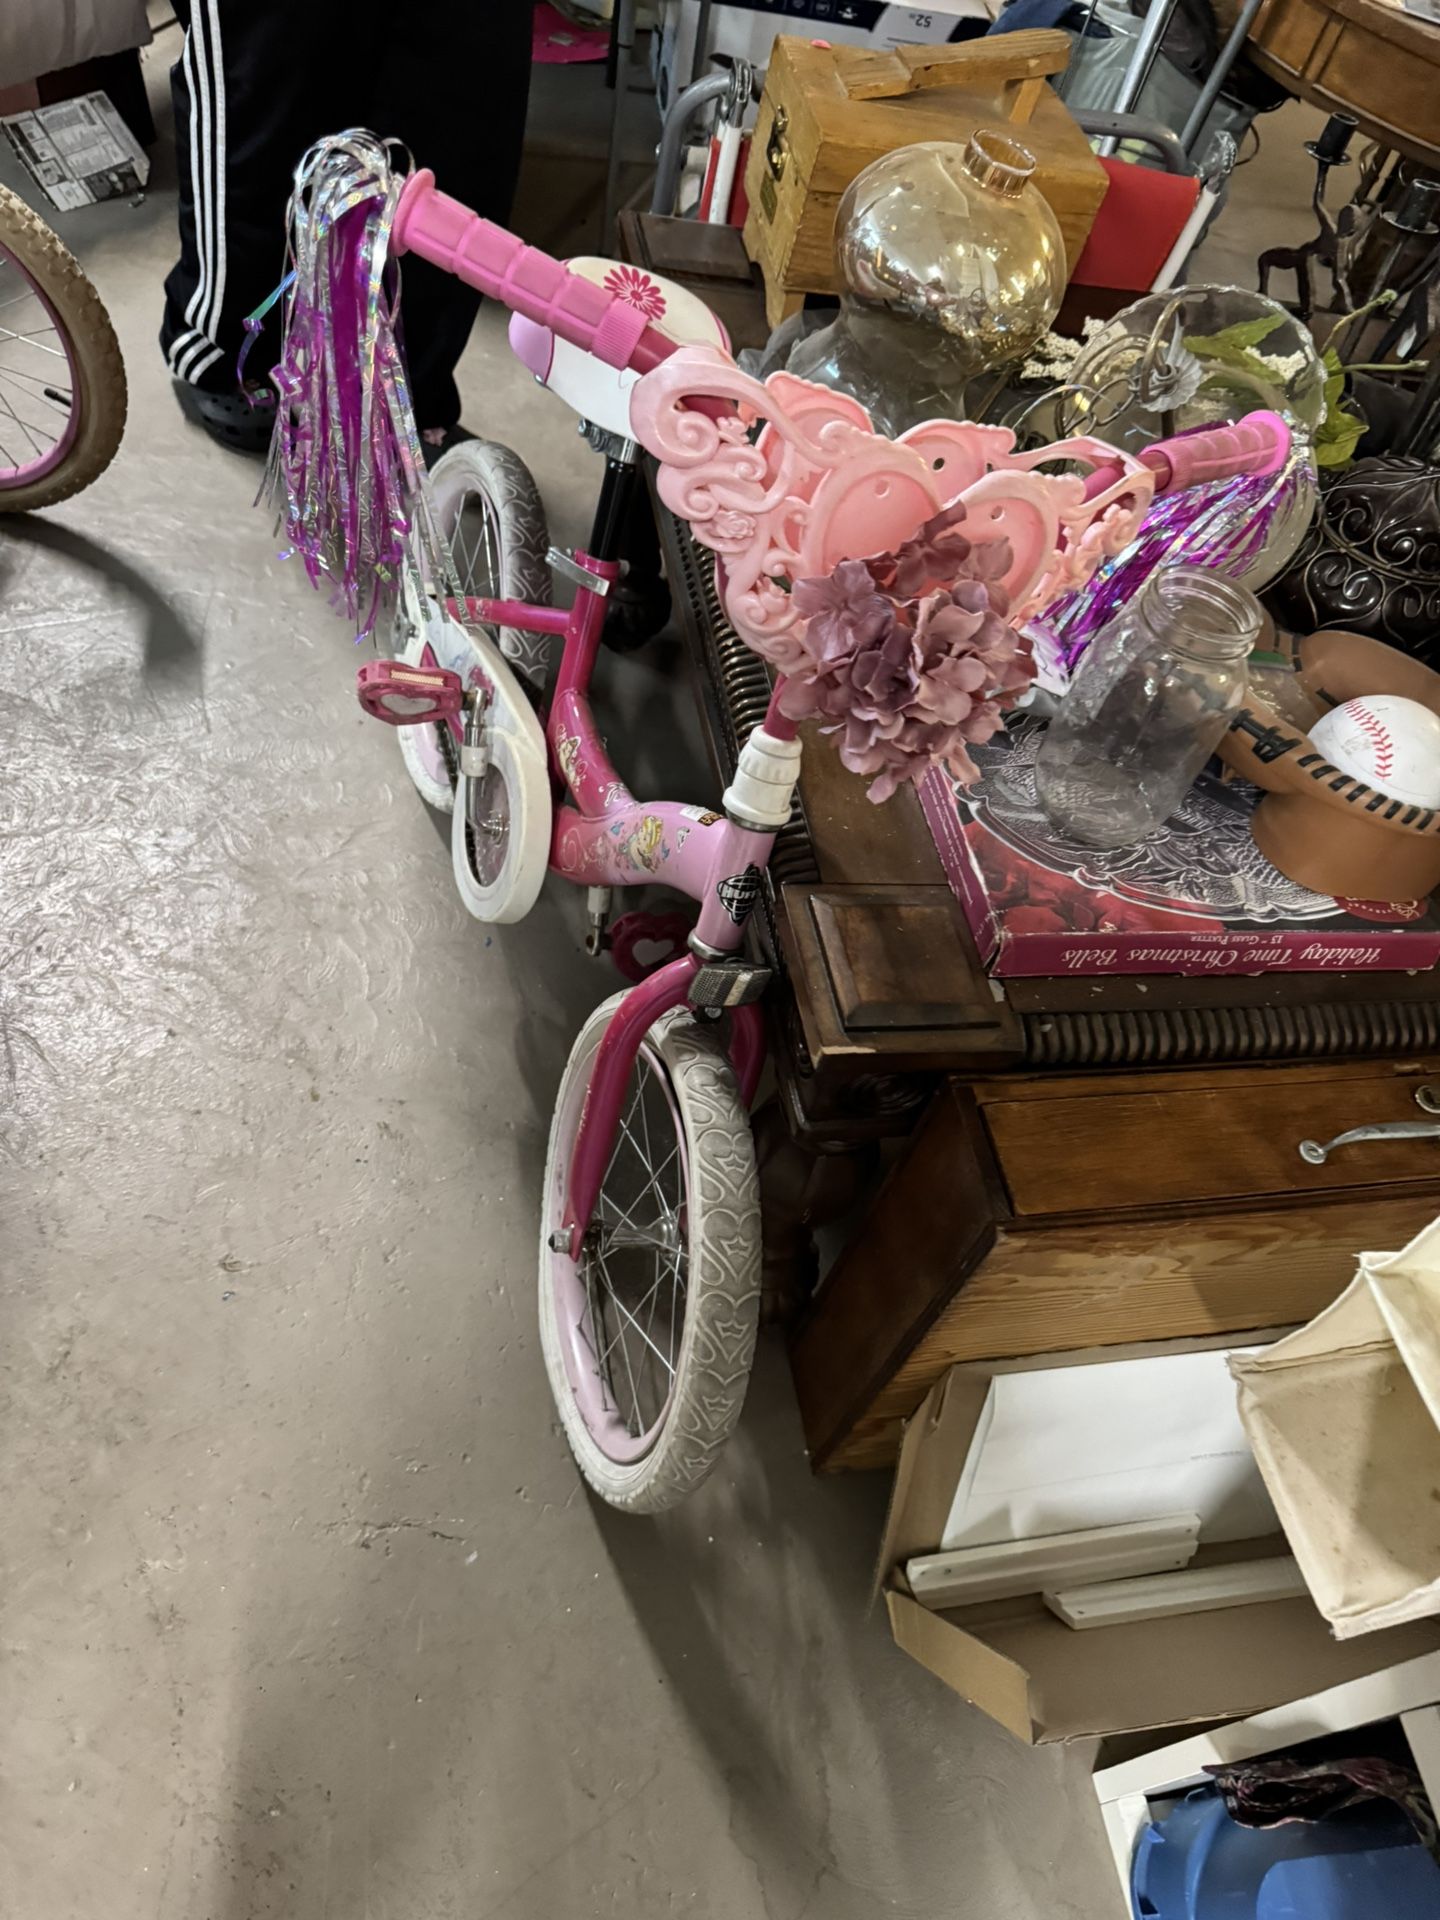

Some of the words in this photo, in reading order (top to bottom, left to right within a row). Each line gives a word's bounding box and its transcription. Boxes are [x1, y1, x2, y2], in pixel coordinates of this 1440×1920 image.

[1062, 949, 1118, 969] Bells
[1127, 949, 1239, 969] Christmas
[1242, 949, 1292, 966] Time
[1299, 943, 1382, 966] Holiday
